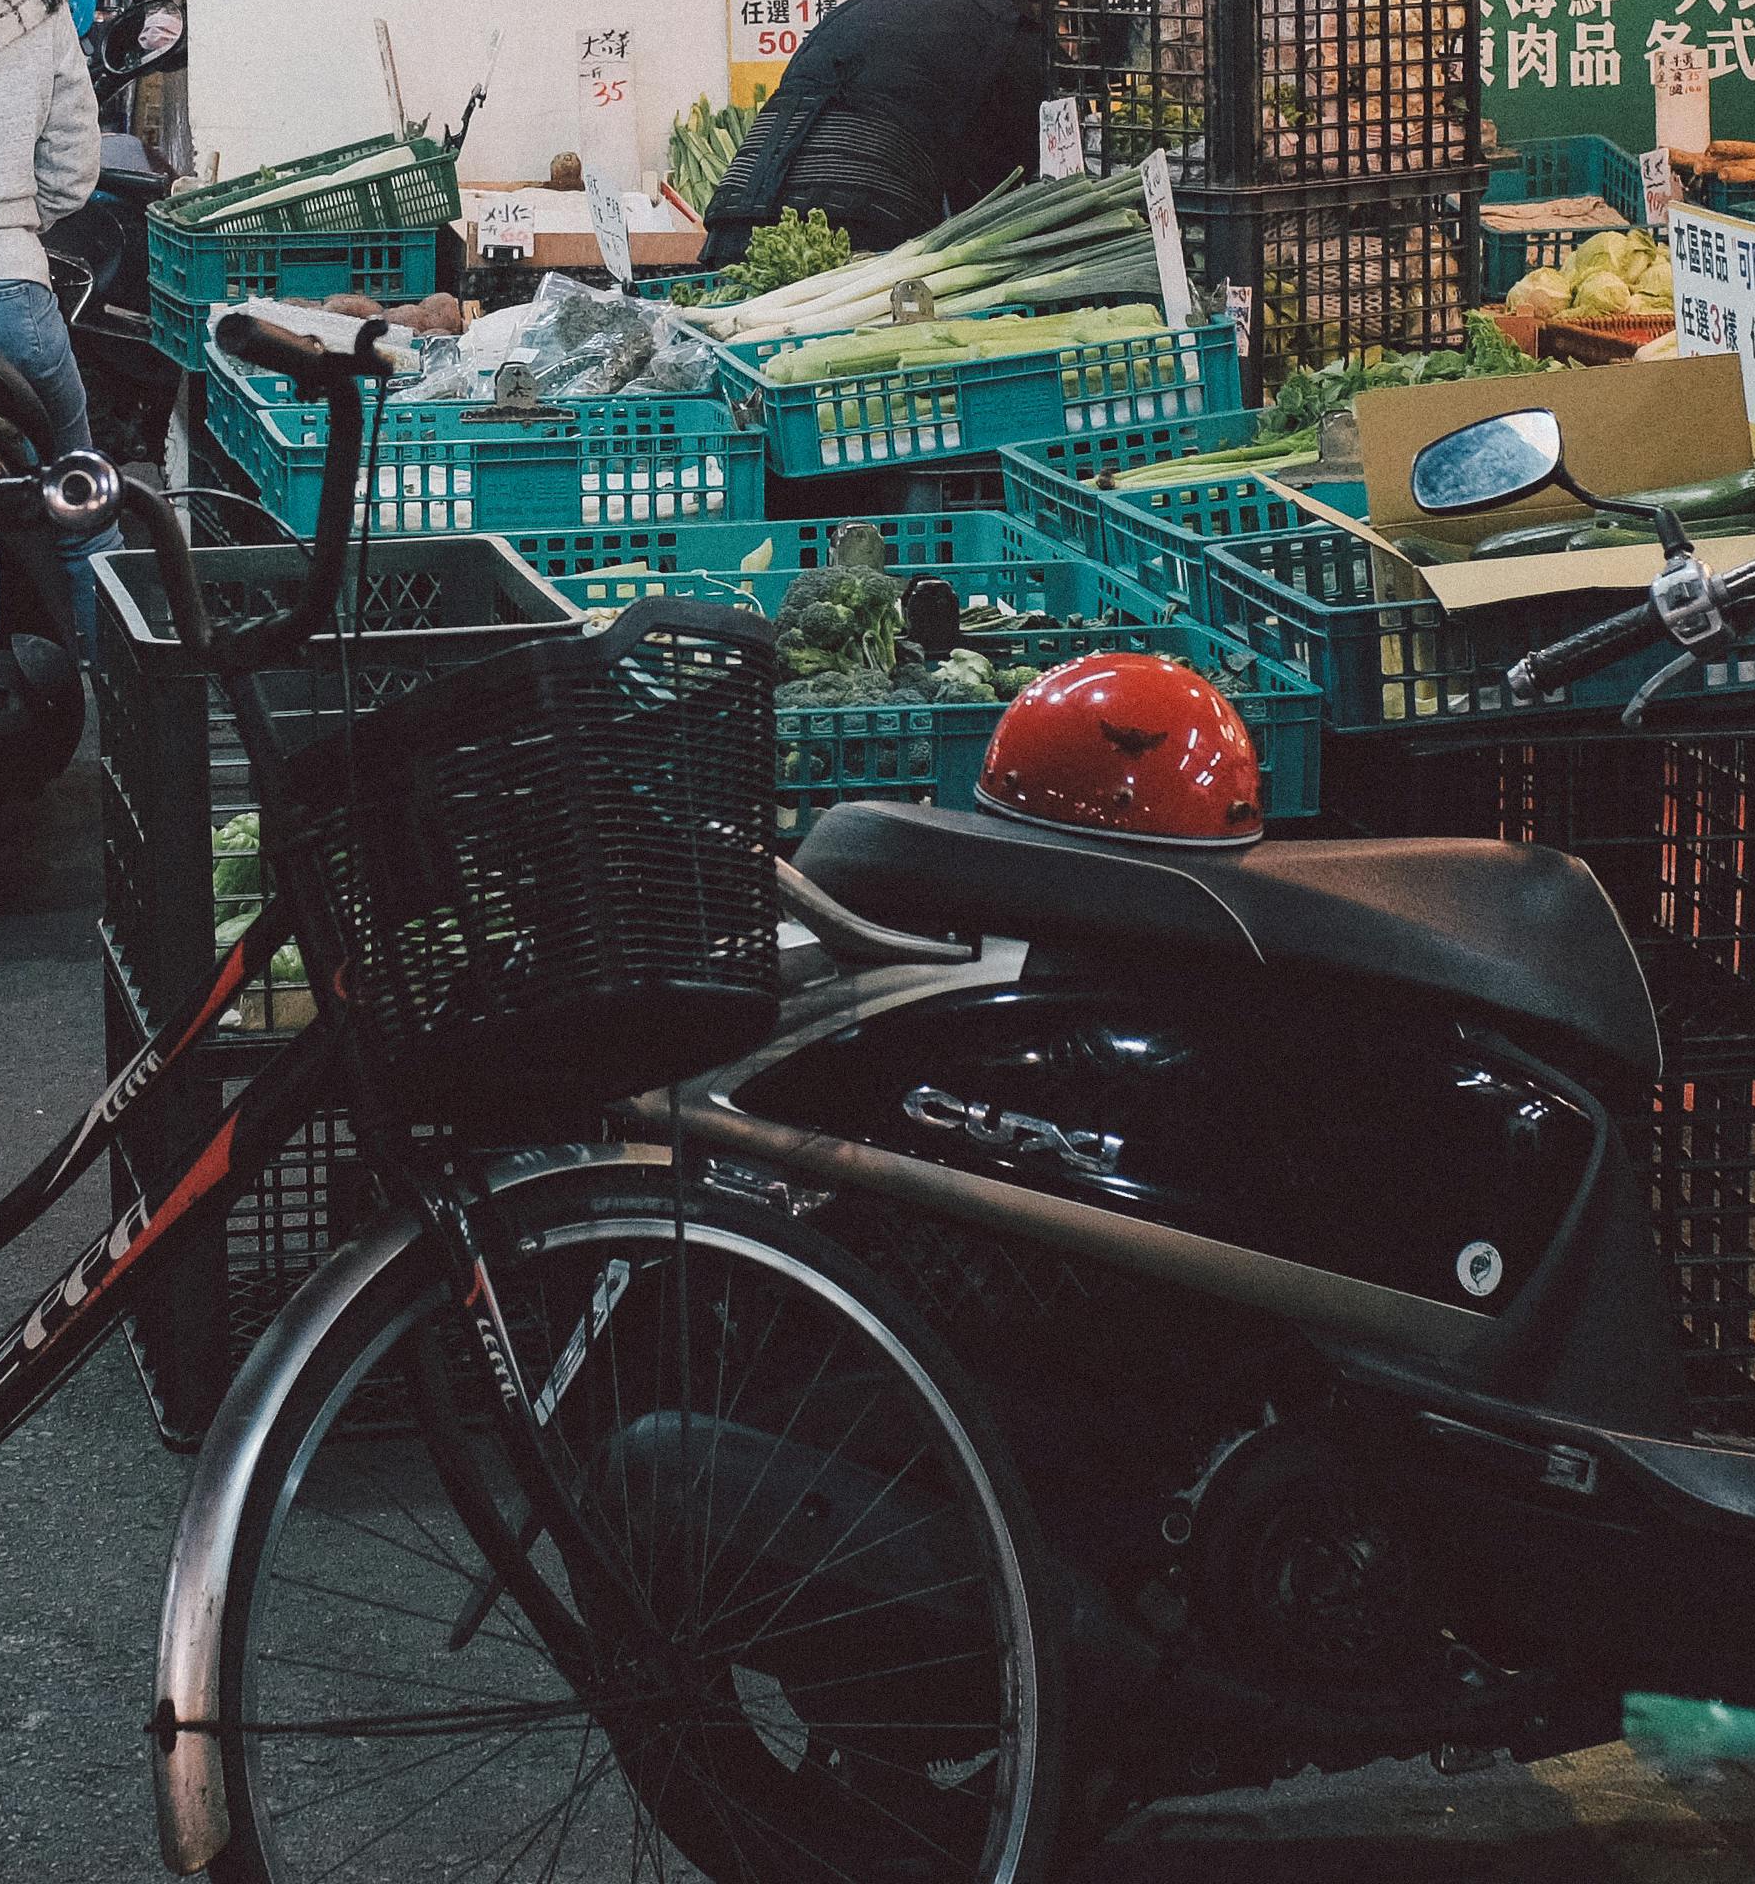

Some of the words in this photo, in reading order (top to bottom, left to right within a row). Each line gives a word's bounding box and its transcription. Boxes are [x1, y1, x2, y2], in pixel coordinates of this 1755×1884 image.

[758, 32, 810, 55] 50
[593, 80, 627, 107] 35
[1674, 219, 1728, 284] 本區商品
[1681, 293, 1738, 352] 任選3樣
